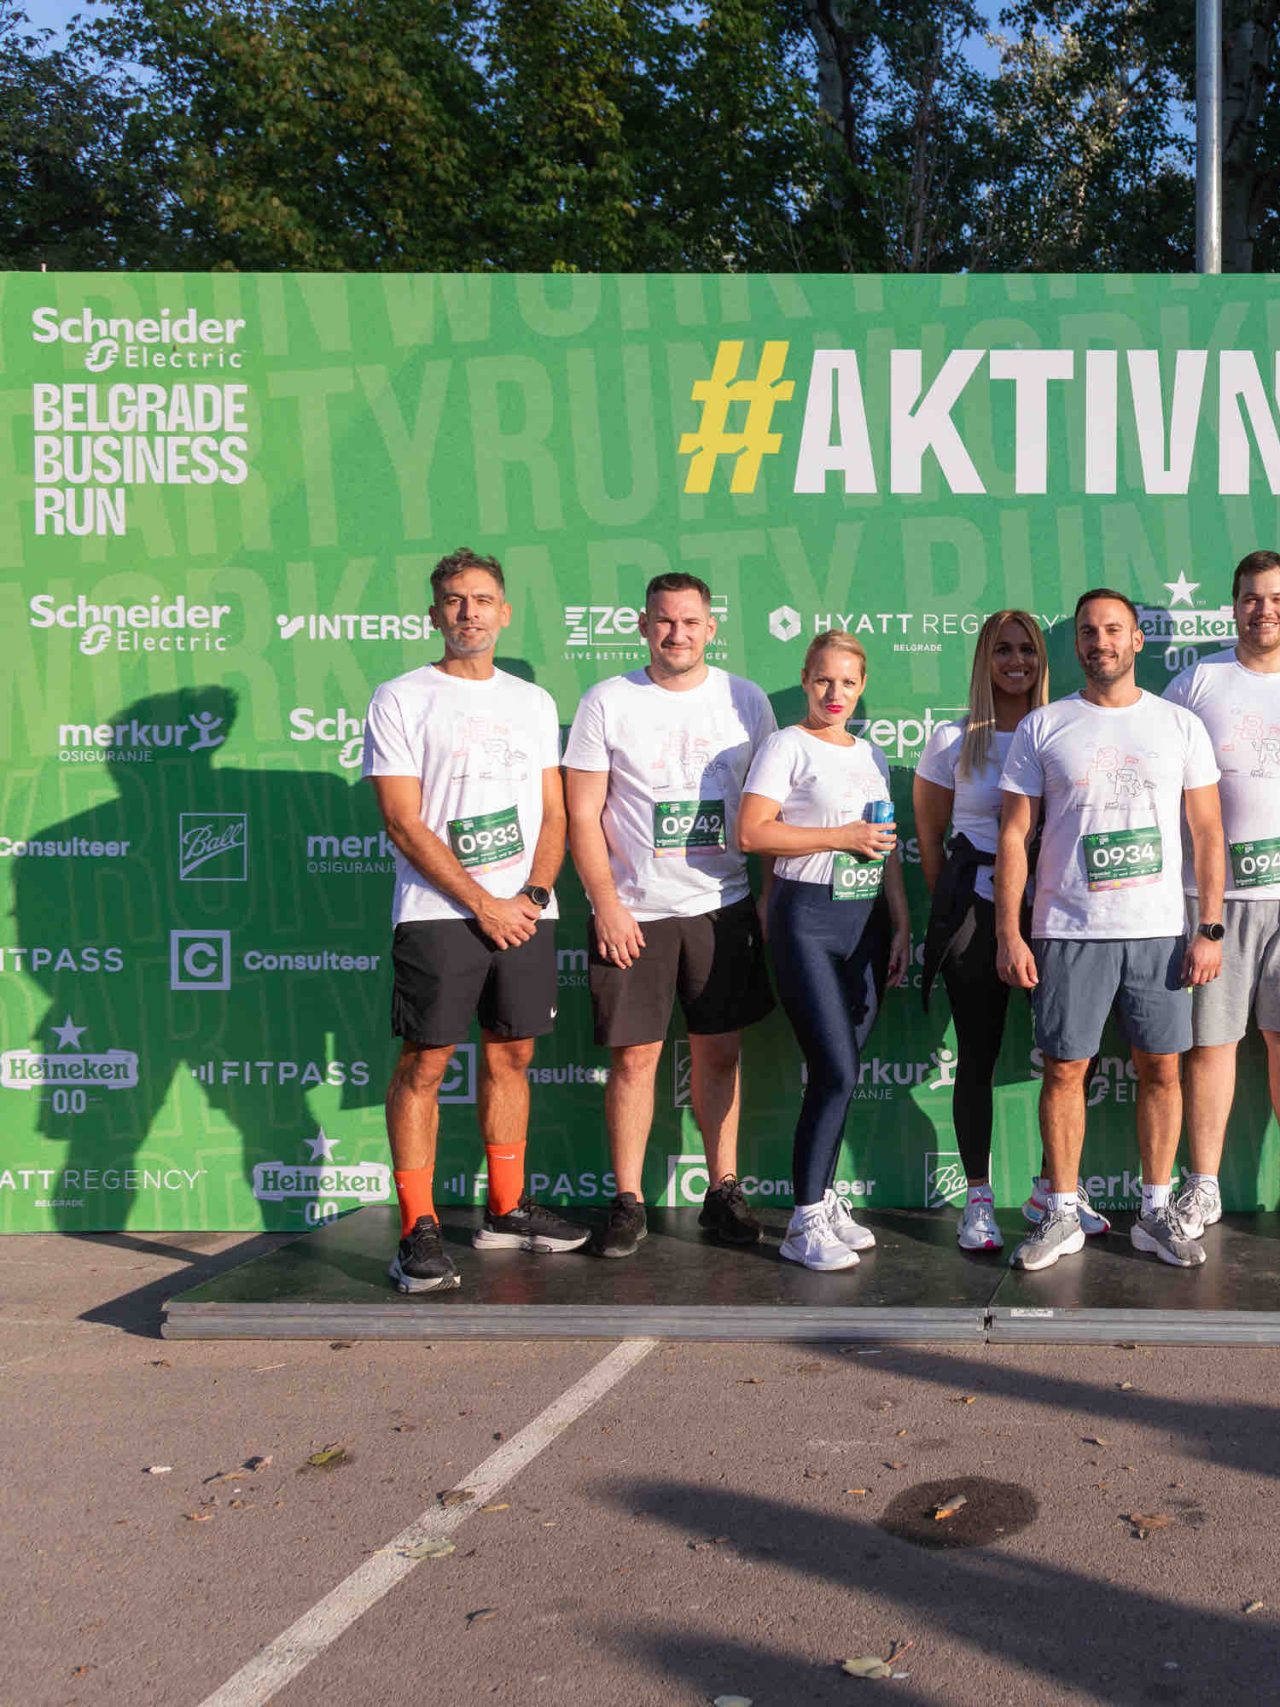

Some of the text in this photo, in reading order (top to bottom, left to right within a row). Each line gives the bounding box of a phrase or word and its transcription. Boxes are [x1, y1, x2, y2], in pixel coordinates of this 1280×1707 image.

[32, 306, 245, 344] Schneider
[125, 346, 243, 368] Electric
[34, 383, 248, 432] BELGRADE
[34, 435, 248, 484] BUSINESS
[35, 488, 125, 536] RUN
[30, 595, 231, 629] Schneider
[814, 613, 914, 634] HYATT
[117, 631, 228, 652] Electric
[59, 719, 189, 747] merkur
[59, 750, 152, 763] OSIGURANJE
[661, 815, 721, 835] 0942
[181, 822, 246, 877] Ball
[458, 823, 519, 854] 0933
[1093, 843, 1156, 868] 0934
[183, 942, 380, 978] C Consulteer
[8, 1058, 130, 1081] Heineken
[221, 1061, 370, 1086] FITPASS
[64, 1170, 200, 1190] REGENCY
[261, 1170, 382, 1193] Heineken
[474, 1174, 617, 1197] FPASS
